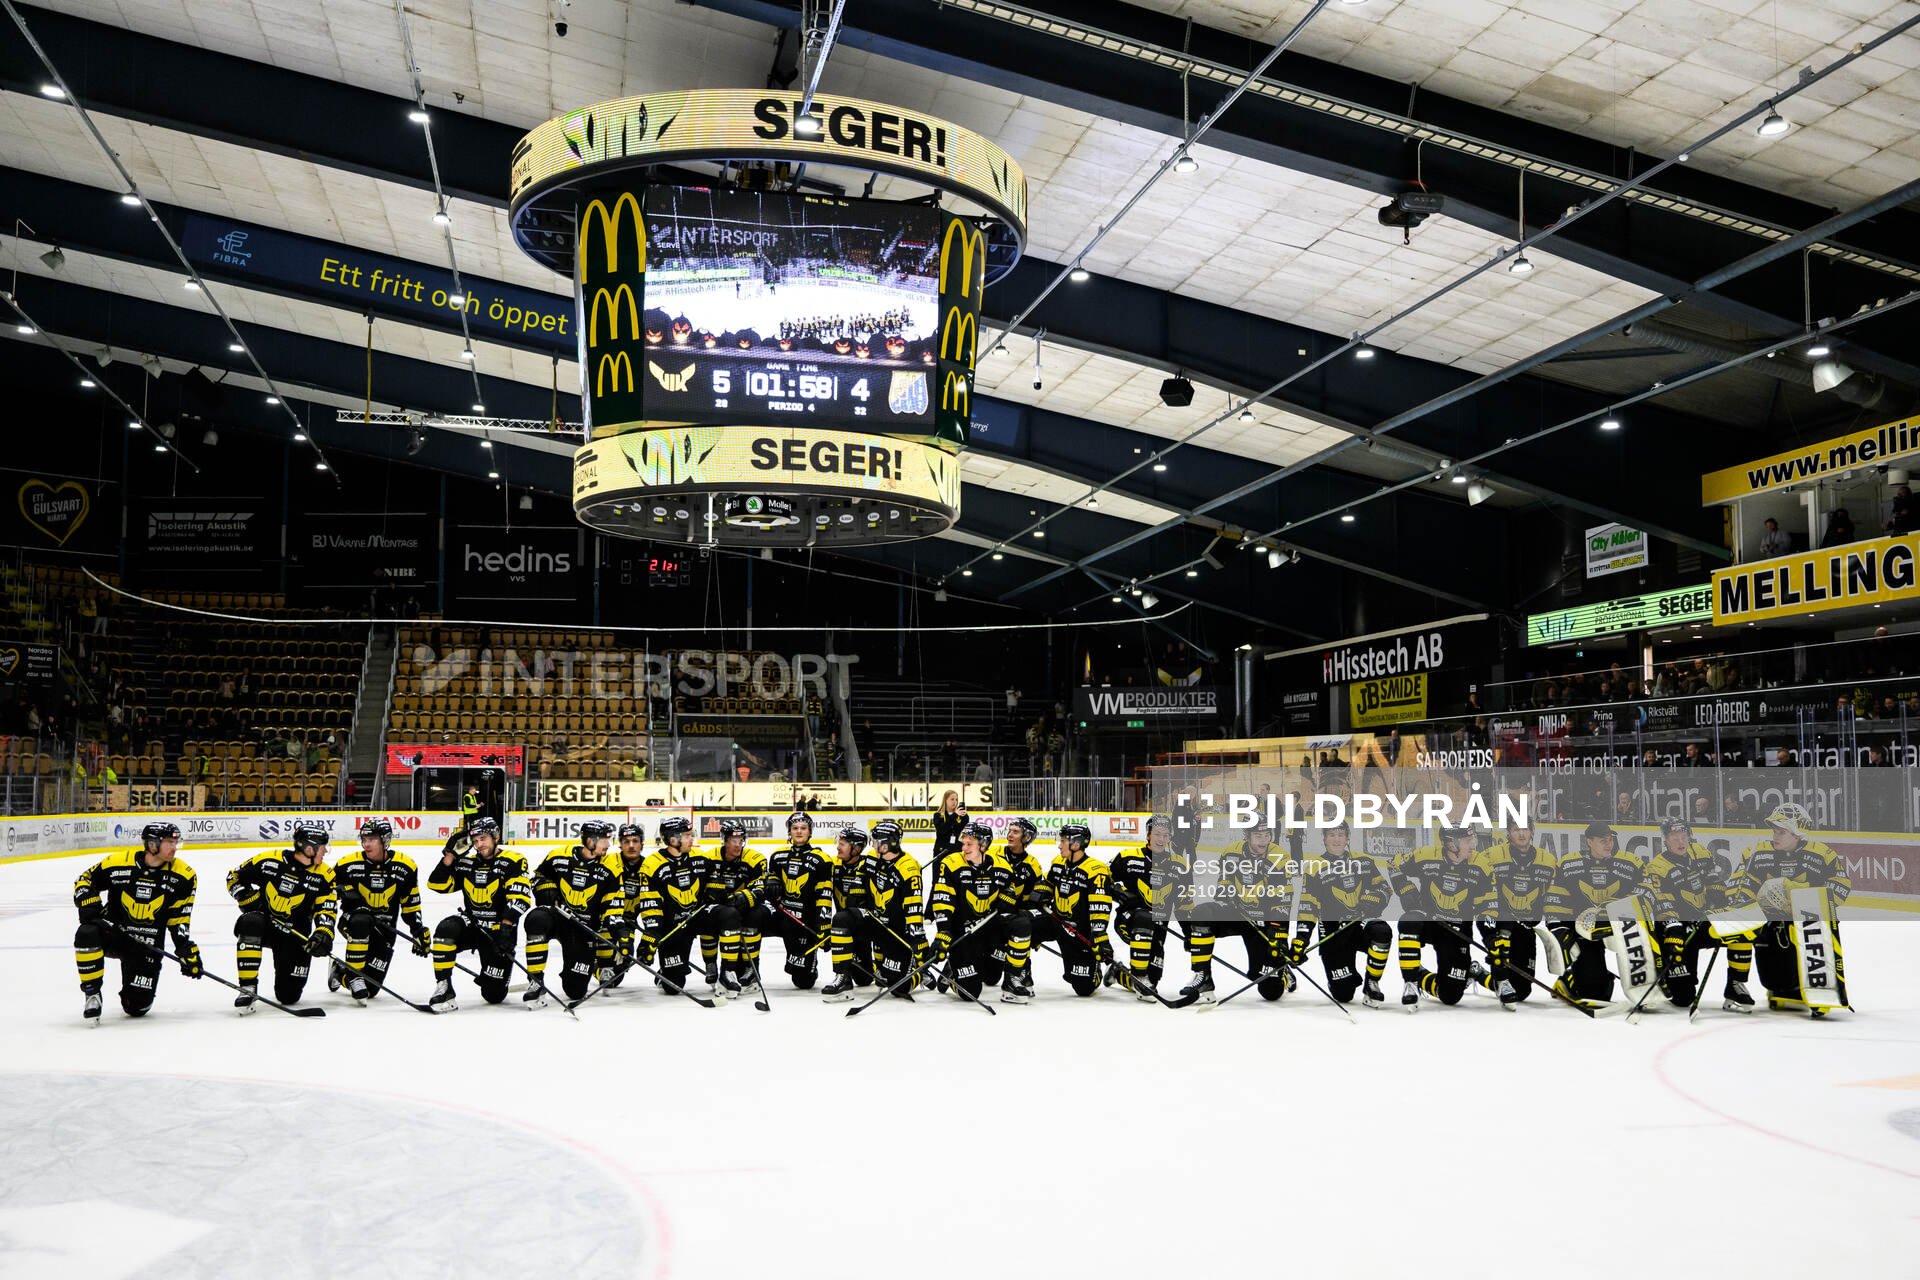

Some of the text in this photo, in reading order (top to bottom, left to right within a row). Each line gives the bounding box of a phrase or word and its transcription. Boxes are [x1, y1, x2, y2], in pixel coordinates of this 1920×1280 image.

[753, 98, 946, 168] SEGER!
[213, 253, 247, 267] FIBRA
[319, 257, 362, 288] Ett
[370, 269, 424, 302] fritt
[489, 298, 569, 335] öppet
[713, 370, 731, 393] 5
[750, 371, 833, 399] 01:58
[850, 378, 870, 401] 4
[768, 401, 815, 412] PERIOD 4
[750, 437, 902, 481] SEGER!
[32, 493, 44, 503] ETT
[33, 499, 80, 515] GULSVART
[158, 521, 247, 532] Isolering Akustik
[148, 544, 254, 553] www.isoleringakustik.se
[1591, 536, 1609, 551] City
[465, 543, 571, 573] hedins
[384, 568, 417, 577] NIBE
[1594, 610, 1646, 625] PROFESSIONAL
[1333, 632, 1444, 683] Hisstech AB
[480, 650, 860, 700] INTERSPORT
[1088, 691, 1217, 715] VM PRODUKTER
[1357, 676, 1422, 715] JB SMIDE
[1695, 702, 1713, 726] LEO
[1715, 699, 1750, 724] ÖBERG
[1539, 754, 1579, 776] notar
[773, 784, 787, 792] GO
[188, 819, 241, 832] JMG VVS
[1093, 875, 1106, 889] 47
[1617, 916, 1648, 987] ALFAB
[1800, 909, 1828, 988] ALFAB
